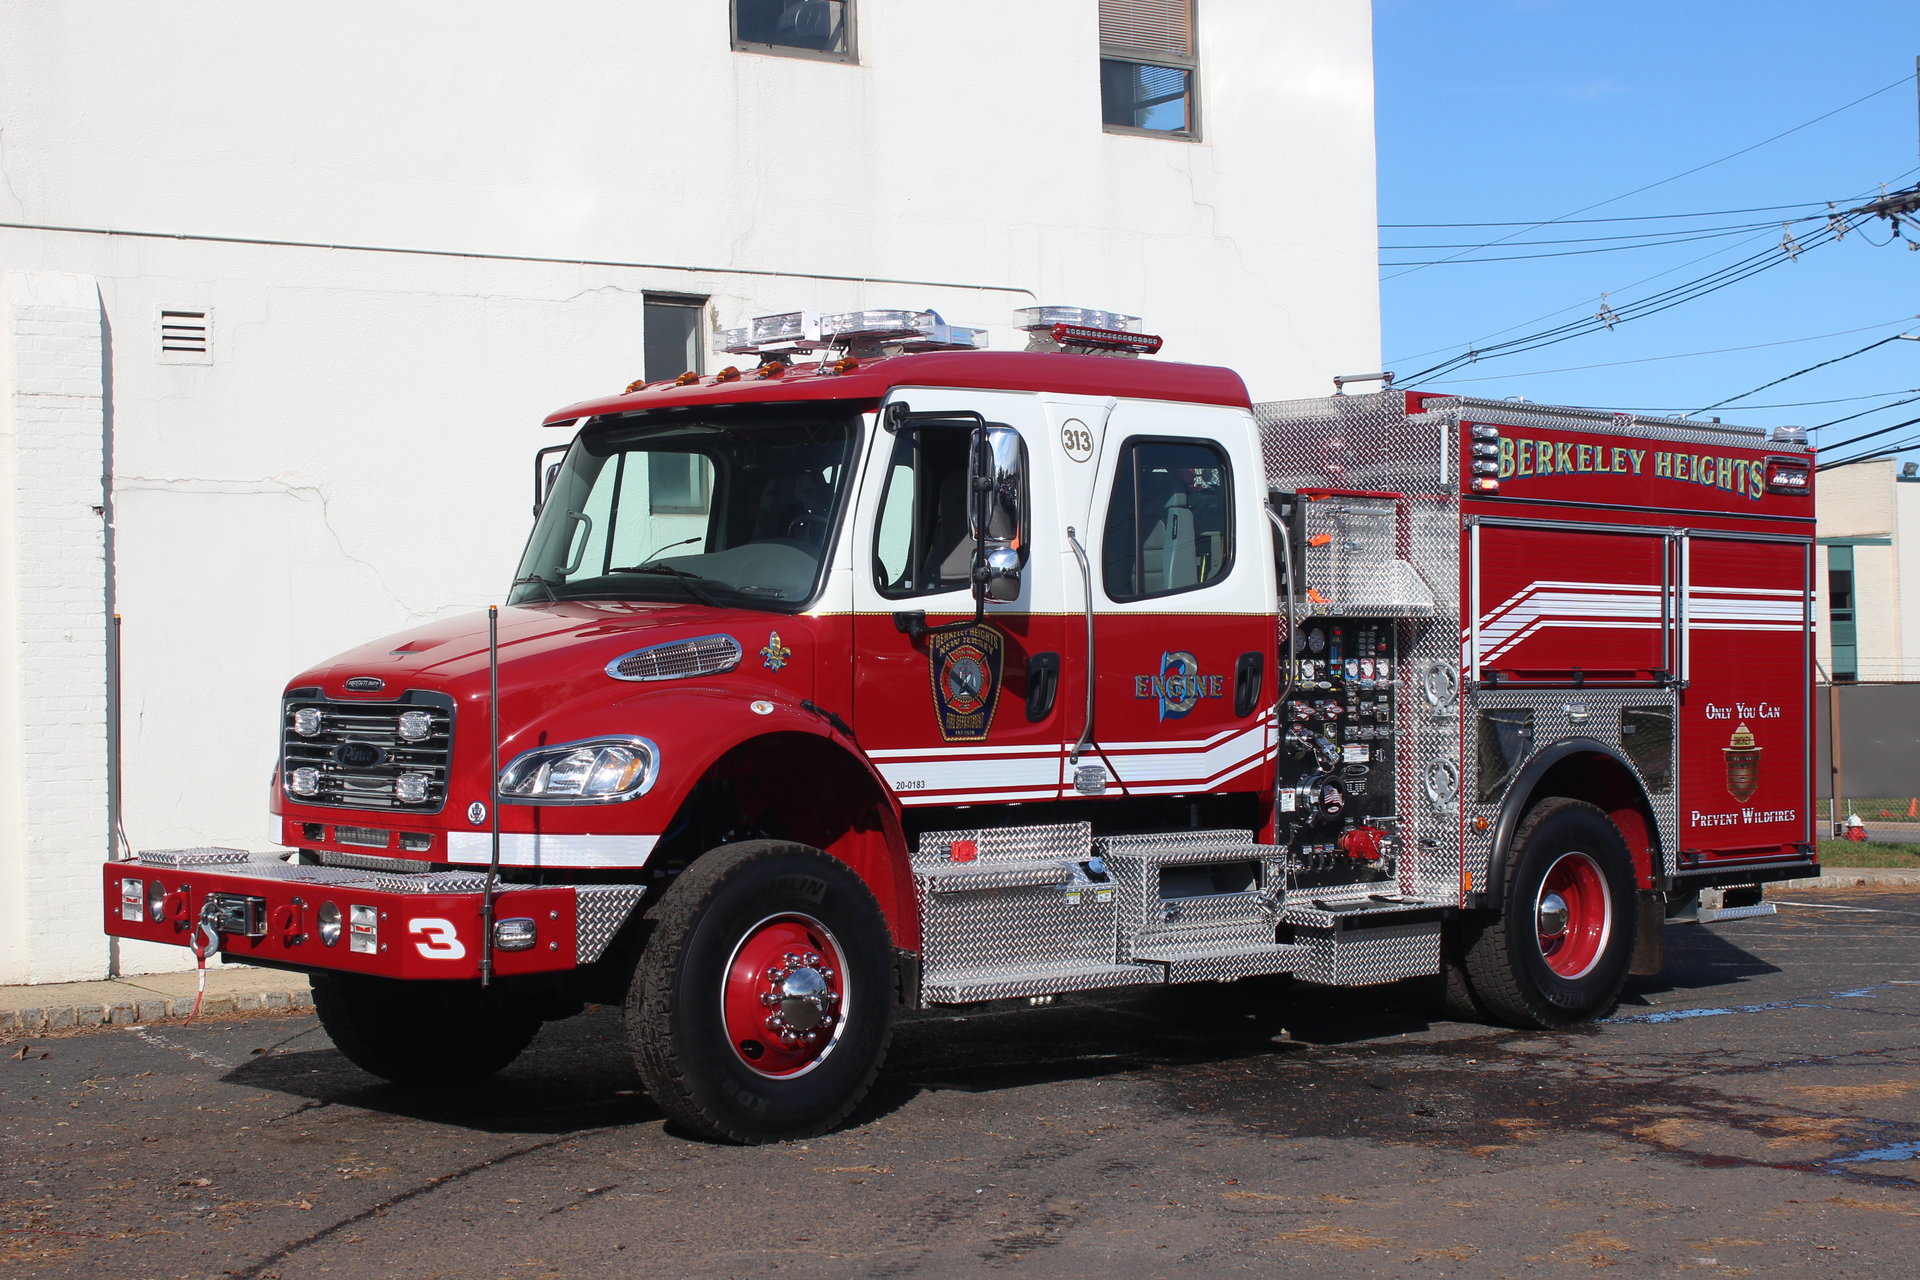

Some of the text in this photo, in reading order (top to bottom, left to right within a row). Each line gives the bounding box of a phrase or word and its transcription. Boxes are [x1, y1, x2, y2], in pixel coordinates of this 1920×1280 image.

[1064, 429, 1091, 452] 313
[1497, 436, 1763, 501] BERKELEY HEIGHTS
[940, 637, 993, 656] NEW JERSEY
[969, 628, 998, 649] HEIGHTS
[1135, 674, 1224, 699] ENGINE
[342, 745, 373, 762] Pierce
[895, 780, 926, 790] 20-0183
[409, 917, 467, 960] 3
